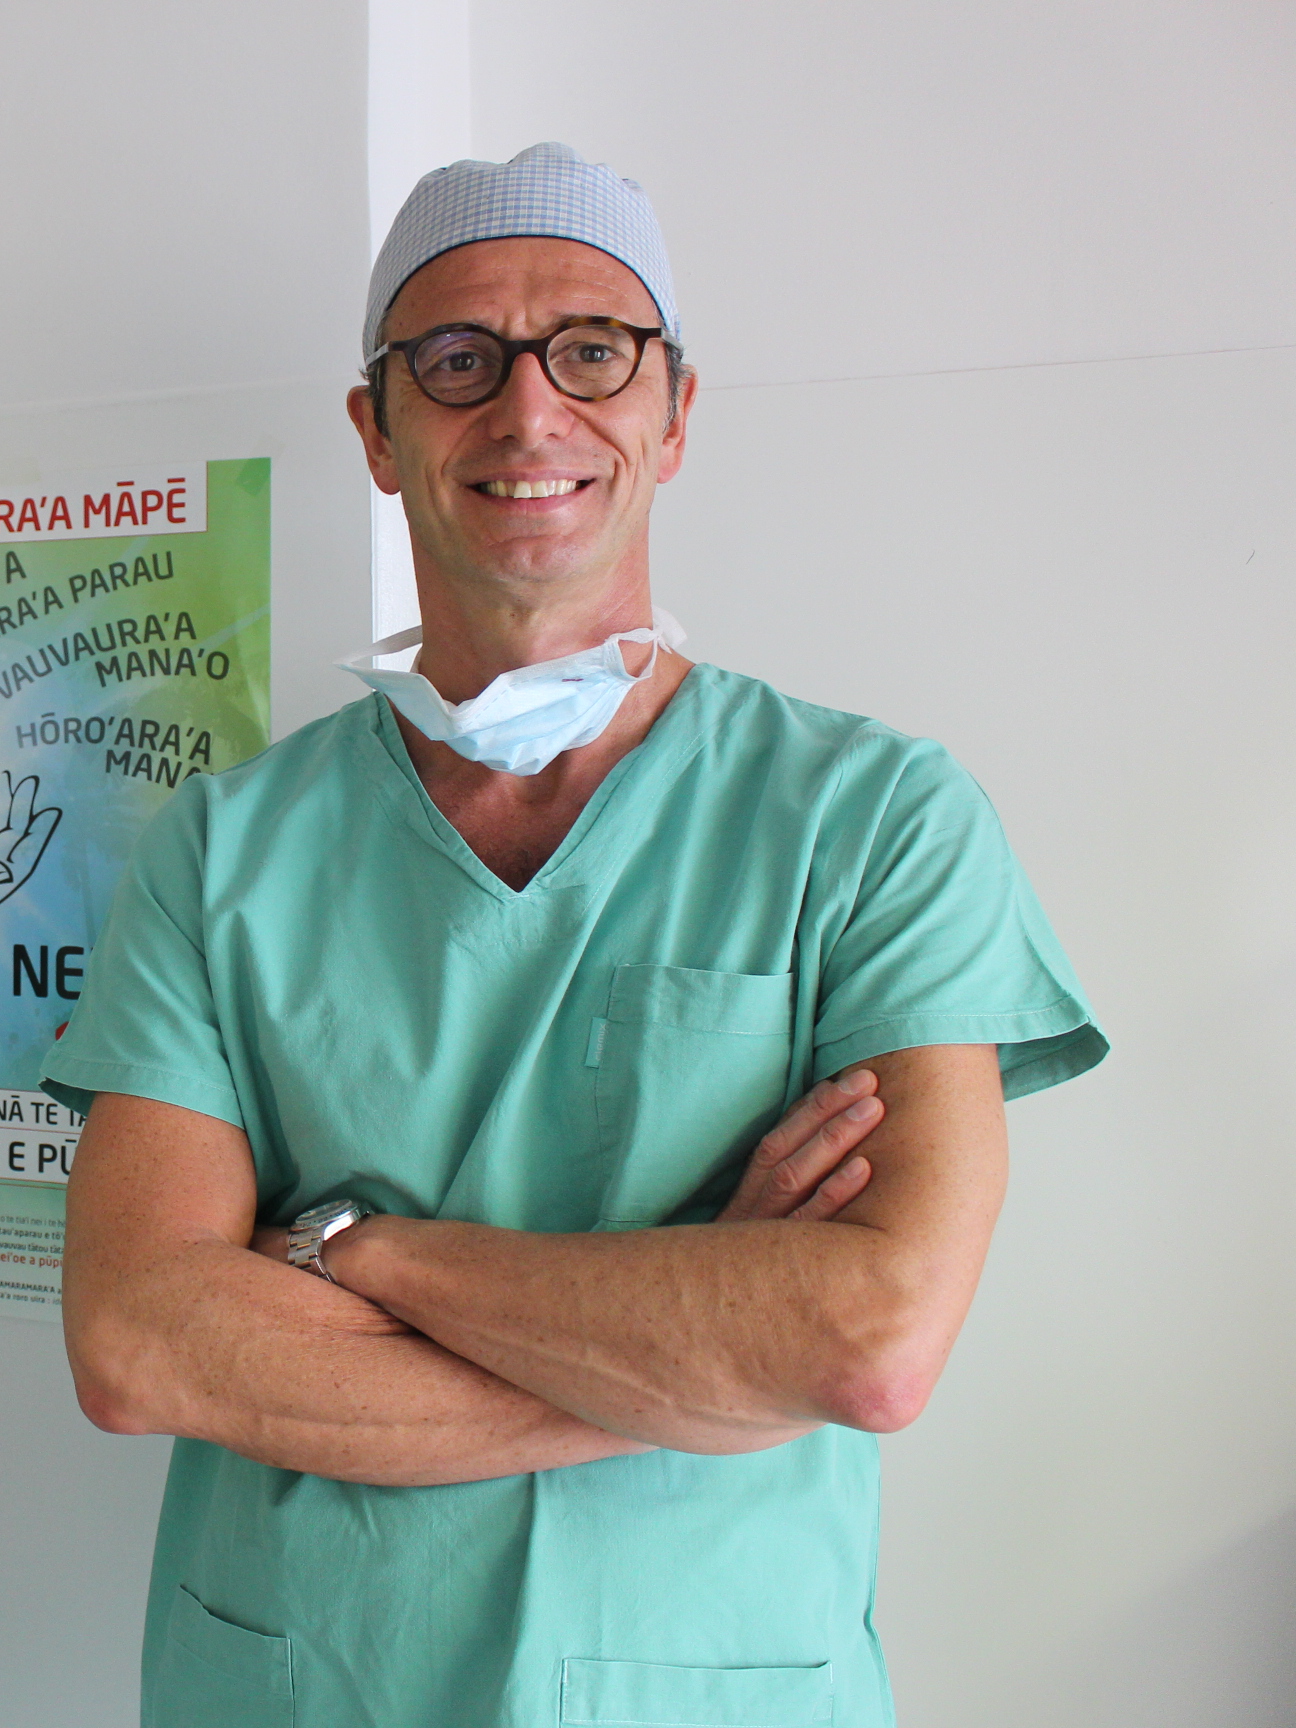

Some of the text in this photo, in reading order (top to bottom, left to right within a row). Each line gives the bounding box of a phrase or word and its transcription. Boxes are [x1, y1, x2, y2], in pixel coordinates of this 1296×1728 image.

[83, 478, 187, 530] MĀPĒ
[68, 551, 174, 604] PARAU
[95, 647, 231, 688] MANA'O
[15, 713, 212, 766] HŌRO'ARA'A
[105, 749, 215, 789] MAN
[13, 944, 94, 1001] NE
[30, 1101, 58, 1125] TE
[8, 1141, 26, 1172] E
[29, 1256, 36, 1266] a
